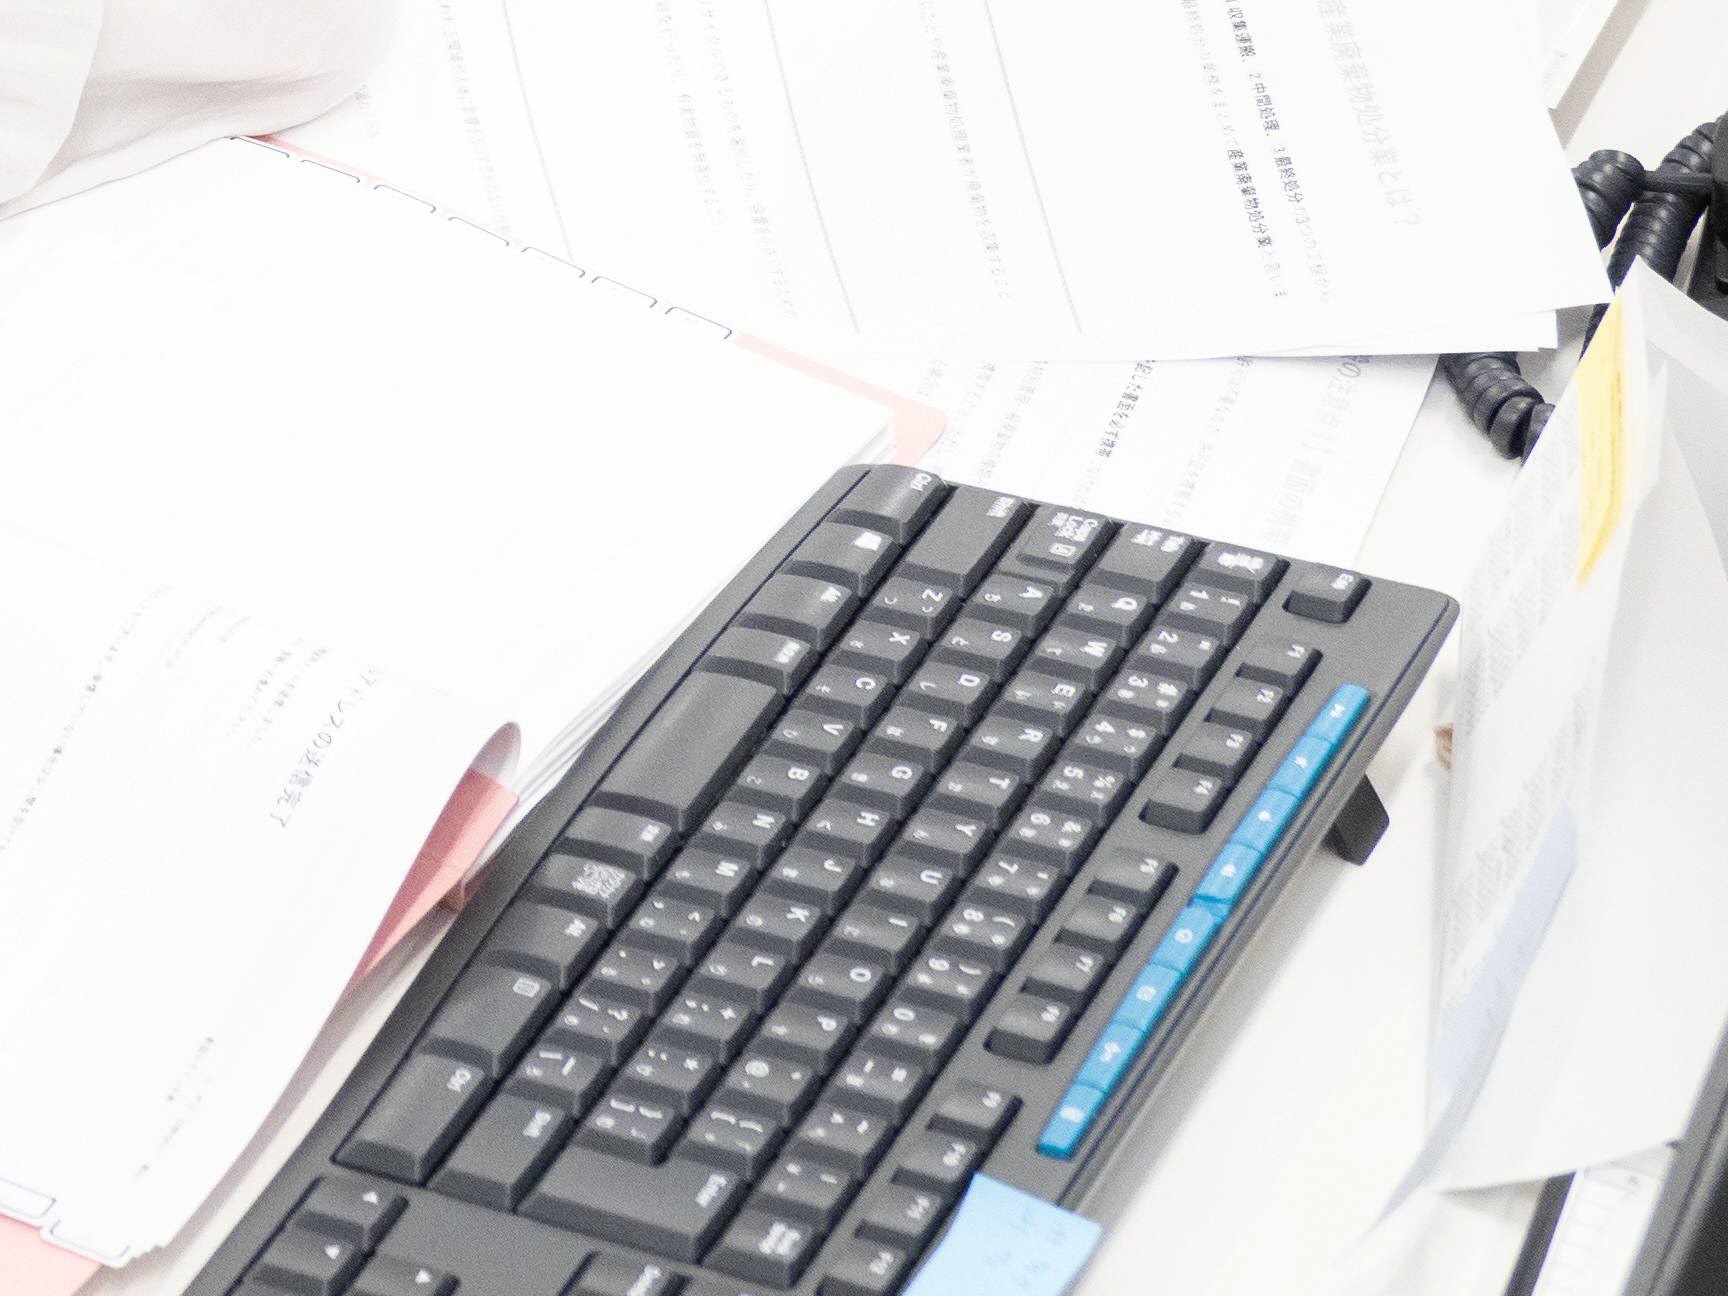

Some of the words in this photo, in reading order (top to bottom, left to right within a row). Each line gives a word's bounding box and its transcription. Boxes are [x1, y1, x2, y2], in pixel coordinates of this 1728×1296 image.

[920, 588, 947, 603] Z
[1018, 585, 1044, 599] A
[1189, 590, 1210, 601] 1
[1110, 596, 1139, 612] Q
[888, 631, 912, 646] X
[990, 629, 1013, 644] S
[1157, 630, 1180, 645] 2
[1079, 640, 1108, 658] W
[855, 676, 877, 691] C
[957, 673, 982, 689] D
[1127, 674, 1149, 689] 3
[1050, 683, 1077, 699] E
[822, 723, 845, 737] V
[929, 718, 949, 733] F
[1094, 720, 1116, 734] 4
[1017, 728, 1045, 744] R
[268, 665, 385, 830] アドレスの送信完了
[787, 766, 811, 781] B
[889, 765, 914, 781] G
[1063, 765, 1085, 780] 5
[988, 777, 1011, 791] T
[752, 813, 776, 830] N
[856, 811, 880, 828] H
[1029, 812, 1052, 827] 6
[955, 823, 977, 838] Y
[715, 860, 740, 878] M
[823, 858, 843, 874] J
[998, 860, 1019, 876] 7
[919, 869, 943, 887] U
[785, 906, 810, 923] K
[962, 908, 985, 923] 8
[888, 917, 909, 928] I
[750, 955, 775, 968] L
[928, 957, 950, 972] 9
[849, 966, 872, 984] O
[893, 1007, 916, 1022] 0
[817, 1015, 838, 1032] P
